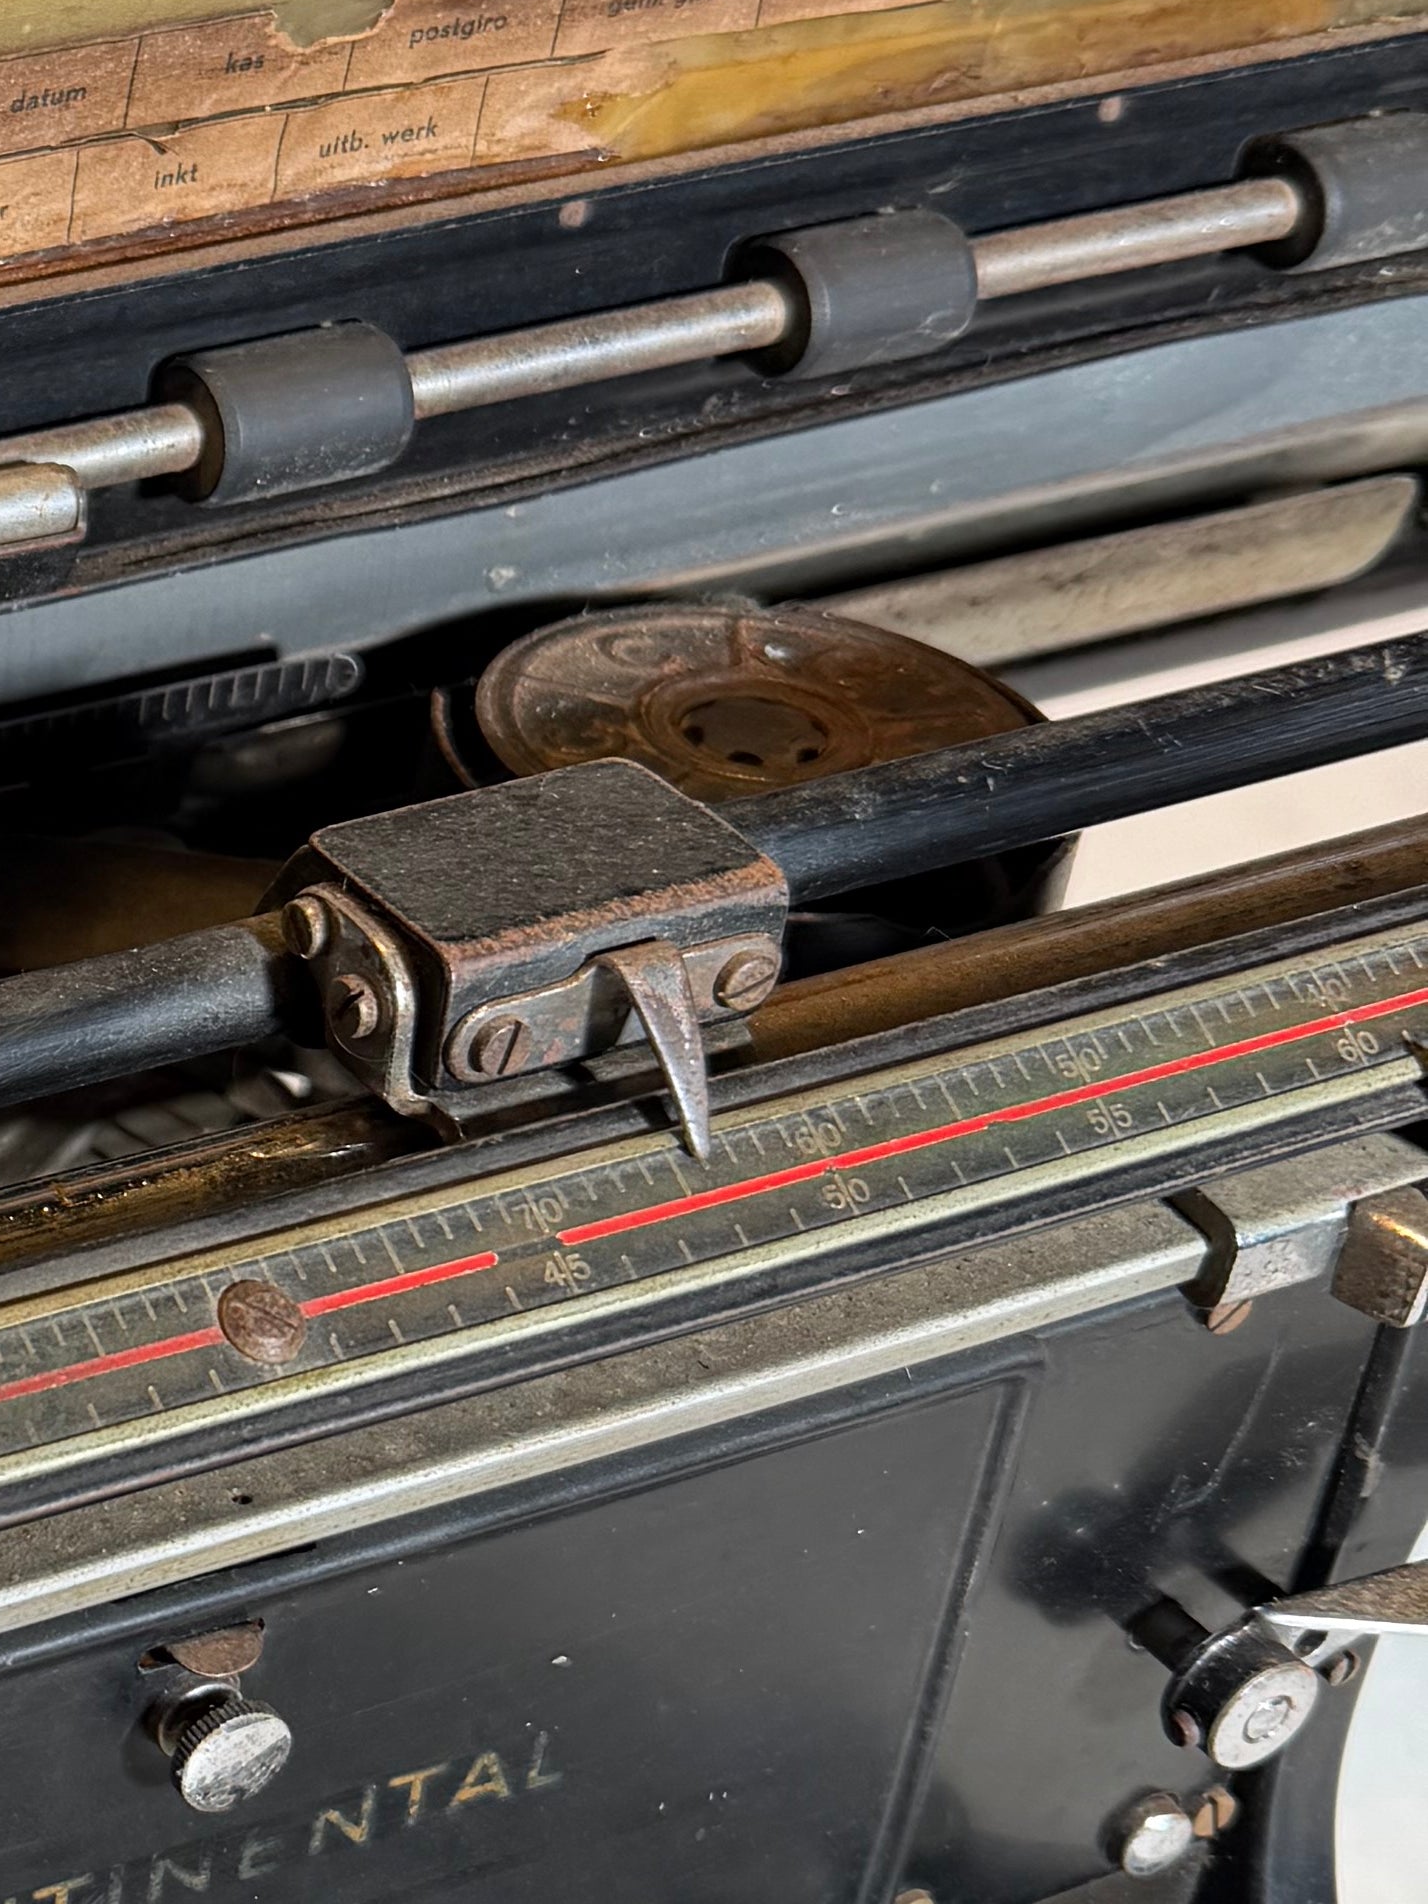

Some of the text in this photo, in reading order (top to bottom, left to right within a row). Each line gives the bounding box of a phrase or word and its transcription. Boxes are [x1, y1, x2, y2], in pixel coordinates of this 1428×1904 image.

[408, 10, 509, 49] postgiro
[224, 51, 266, 76] kas
[8, 82, 88, 115] datum
[317, 117, 439, 160] uitb. werk
[152, 161, 200, 191] inkt
[1336, 1028, 1381, 1064] 60
[1055, 1046, 1103, 1081] 50
[1088, 1102, 1134, 1136] 55
